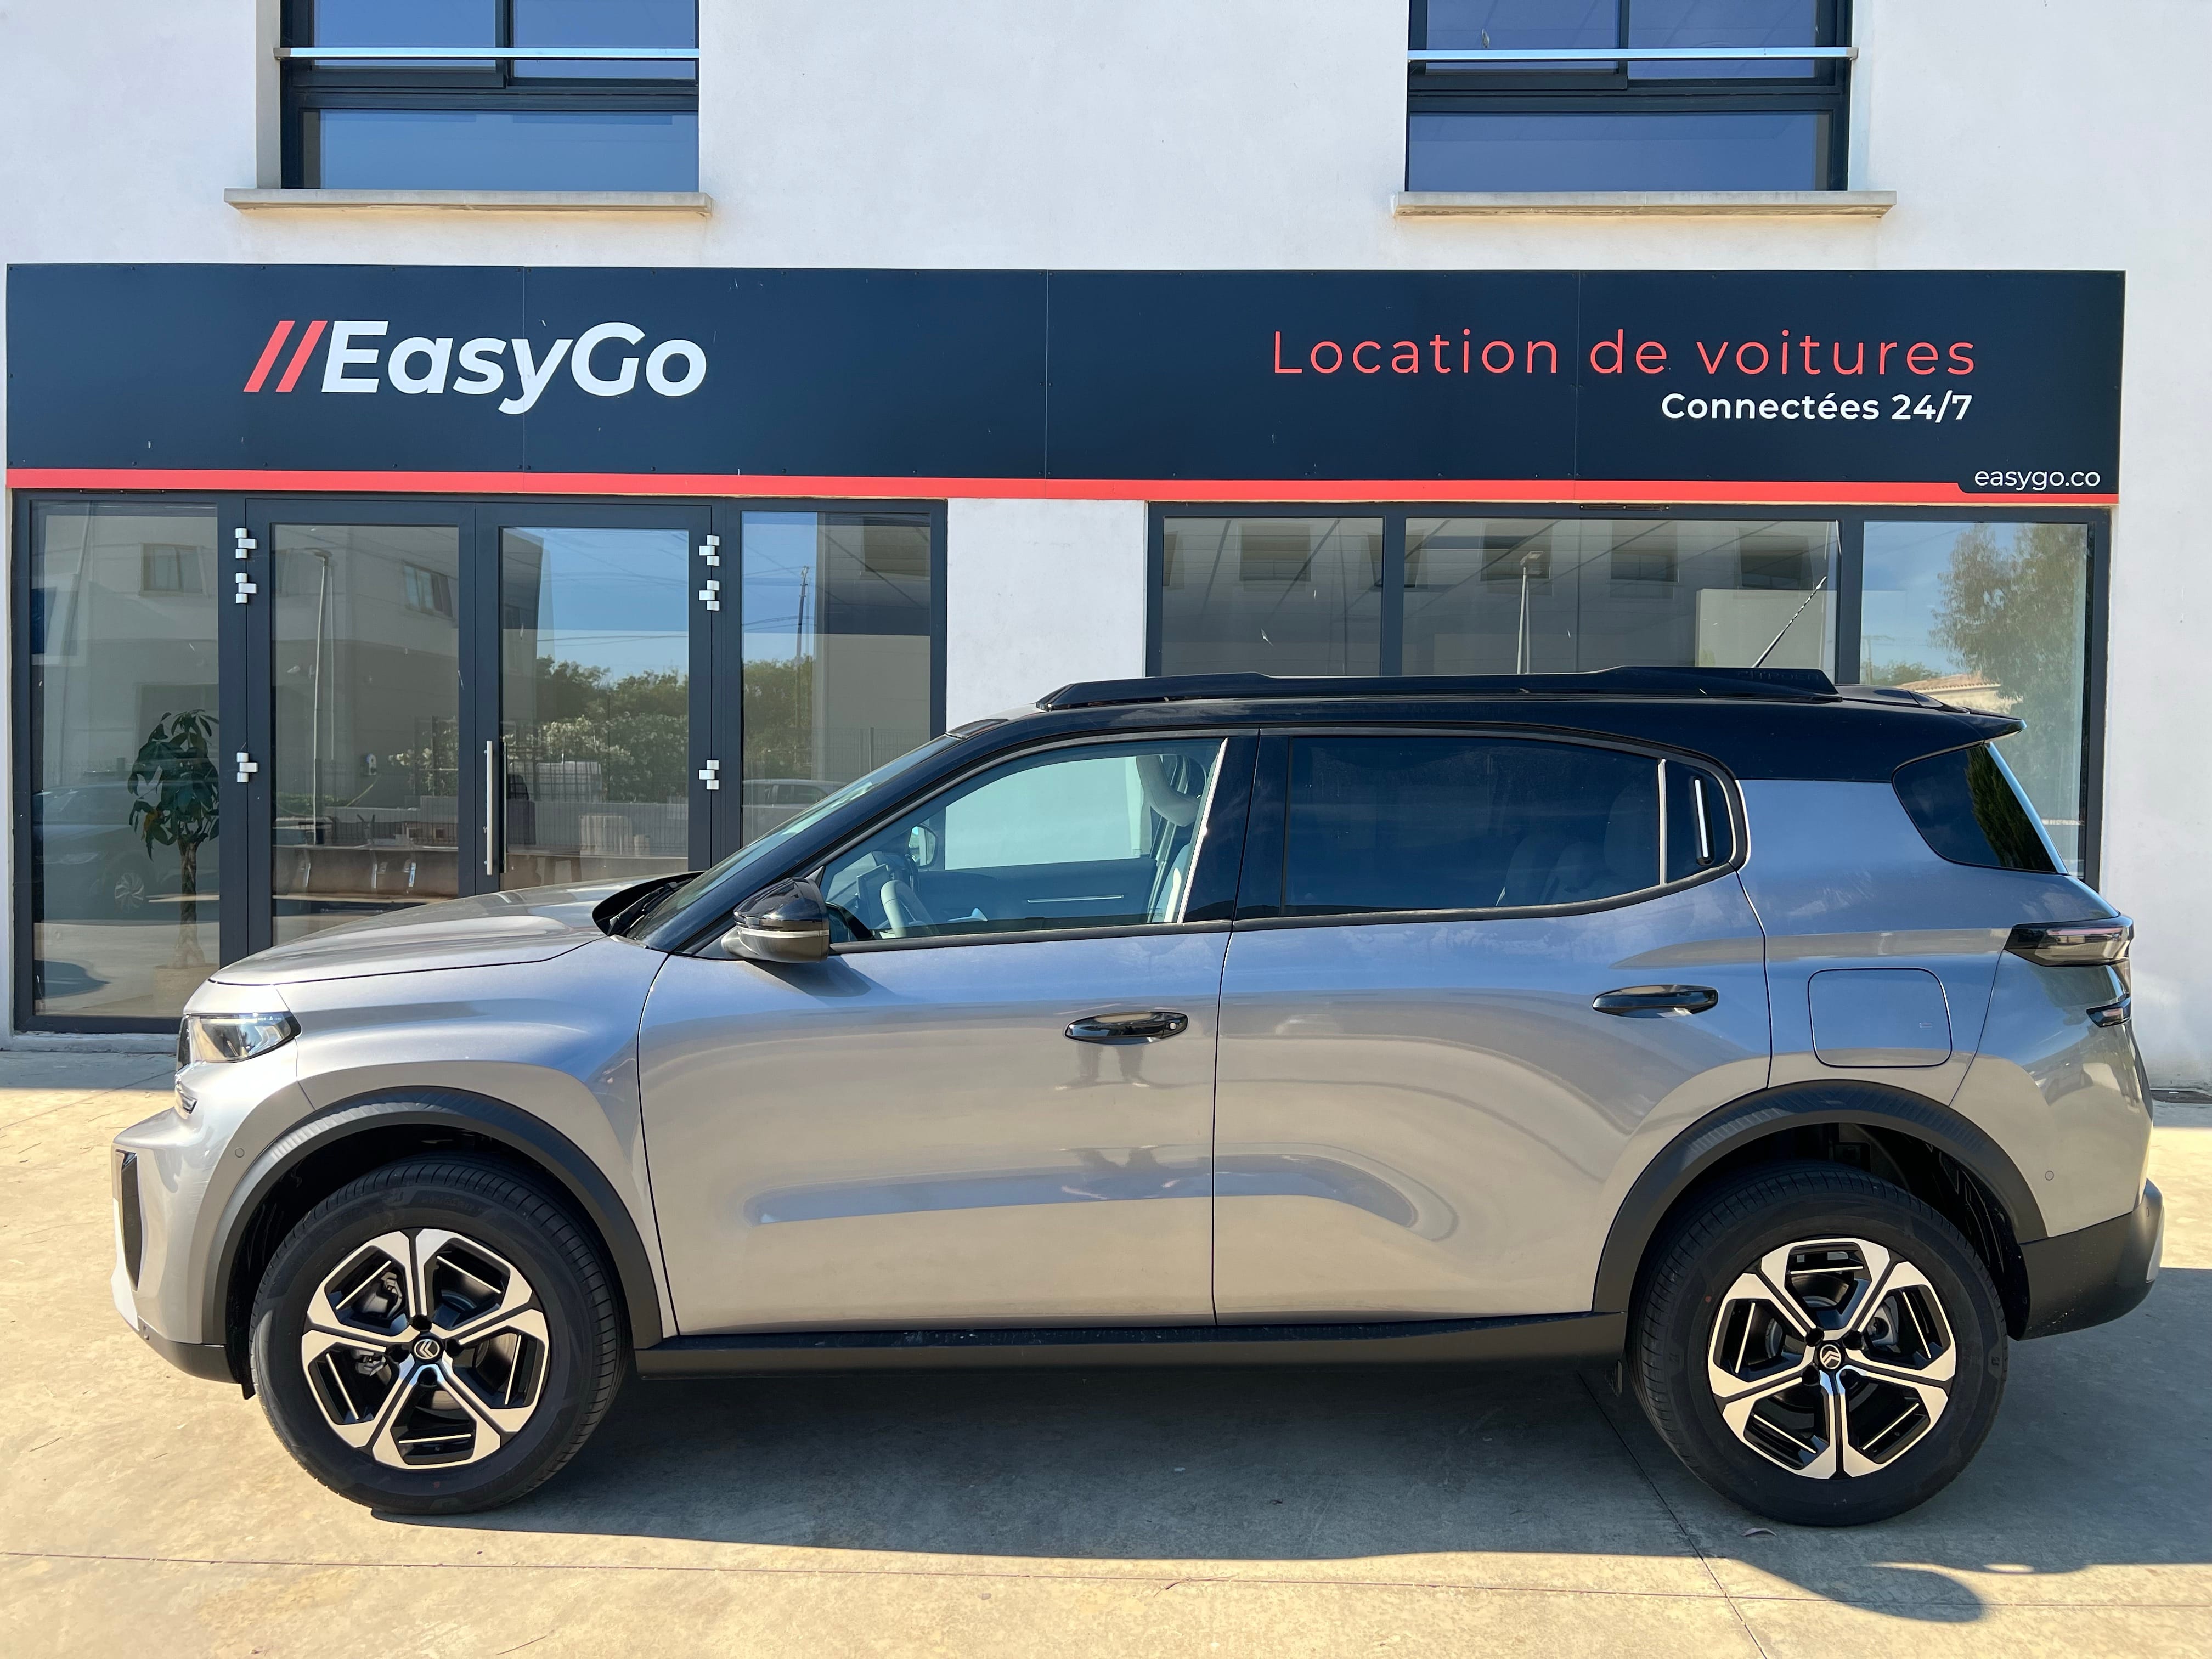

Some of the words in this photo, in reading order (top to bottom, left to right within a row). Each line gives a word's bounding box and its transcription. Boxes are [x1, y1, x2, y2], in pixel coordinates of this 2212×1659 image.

[1274, 329, 1557, 374] Location
[1590, 329, 1667, 374] de
[1697, 329, 1974, 375] voitures
[1662, 393, 1880, 420] Connectées
[1892, 390, 1972, 423] 24/7
[1975, 471, 2101, 491] easygo.co
